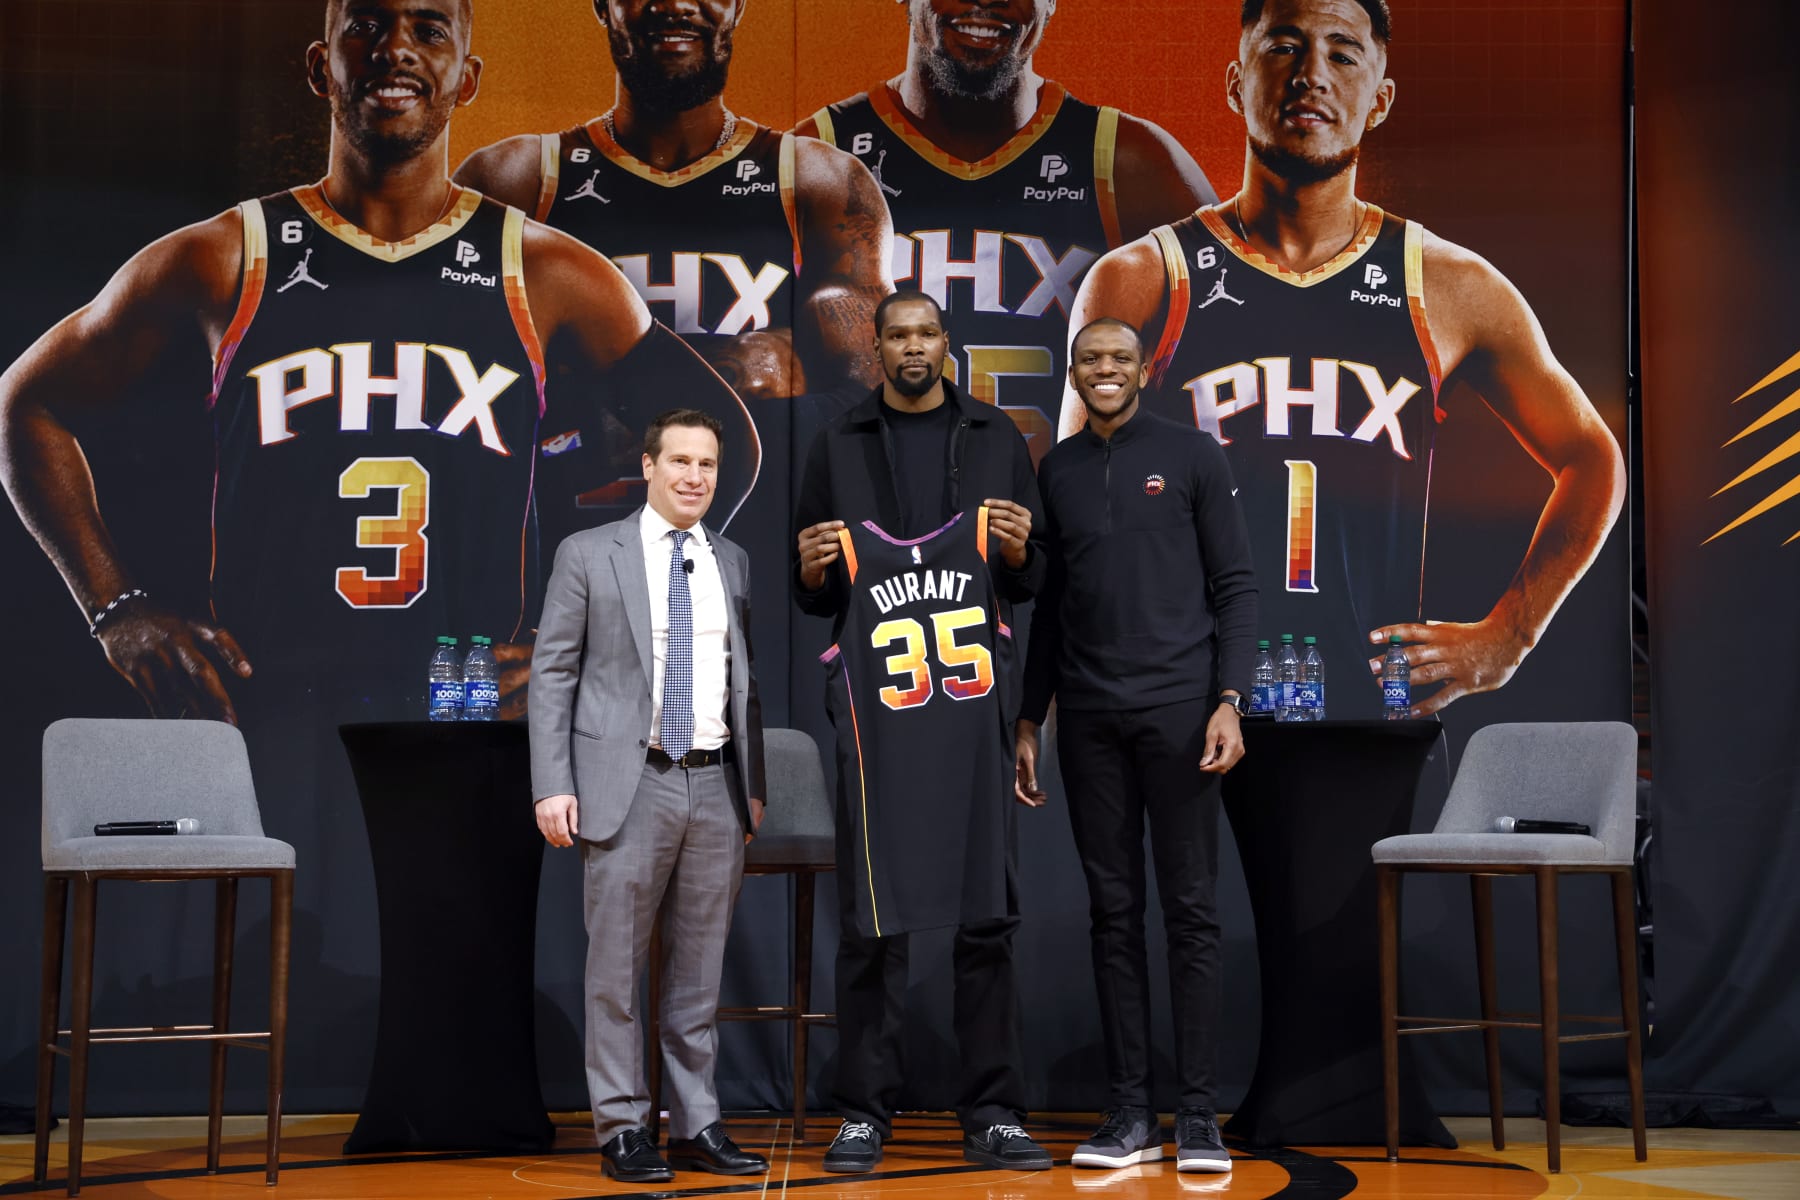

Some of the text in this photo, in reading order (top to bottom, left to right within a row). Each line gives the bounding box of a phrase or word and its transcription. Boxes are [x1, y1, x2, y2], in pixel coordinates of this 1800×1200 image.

[570, 148, 591, 163] 6
[852, 132, 873, 155] 6
[722, 182, 776, 196] PayPal
[1023, 186, 1084, 201] PayPal
[281, 220, 303, 243] 6
[1197, 246, 1216, 270] 6
[441, 266, 496, 288] PayPal
[612, 251, 789, 337] HX
[1350, 289, 1402, 308] PayPal
[246, 341, 520, 457] PHX
[1182, 356, 1423, 461] PHX
[335, 456, 431, 609] 3
[1283, 459, 1319, 593] 1
[869, 569, 973, 615] DURANT
[871, 605, 995, 711] 35
